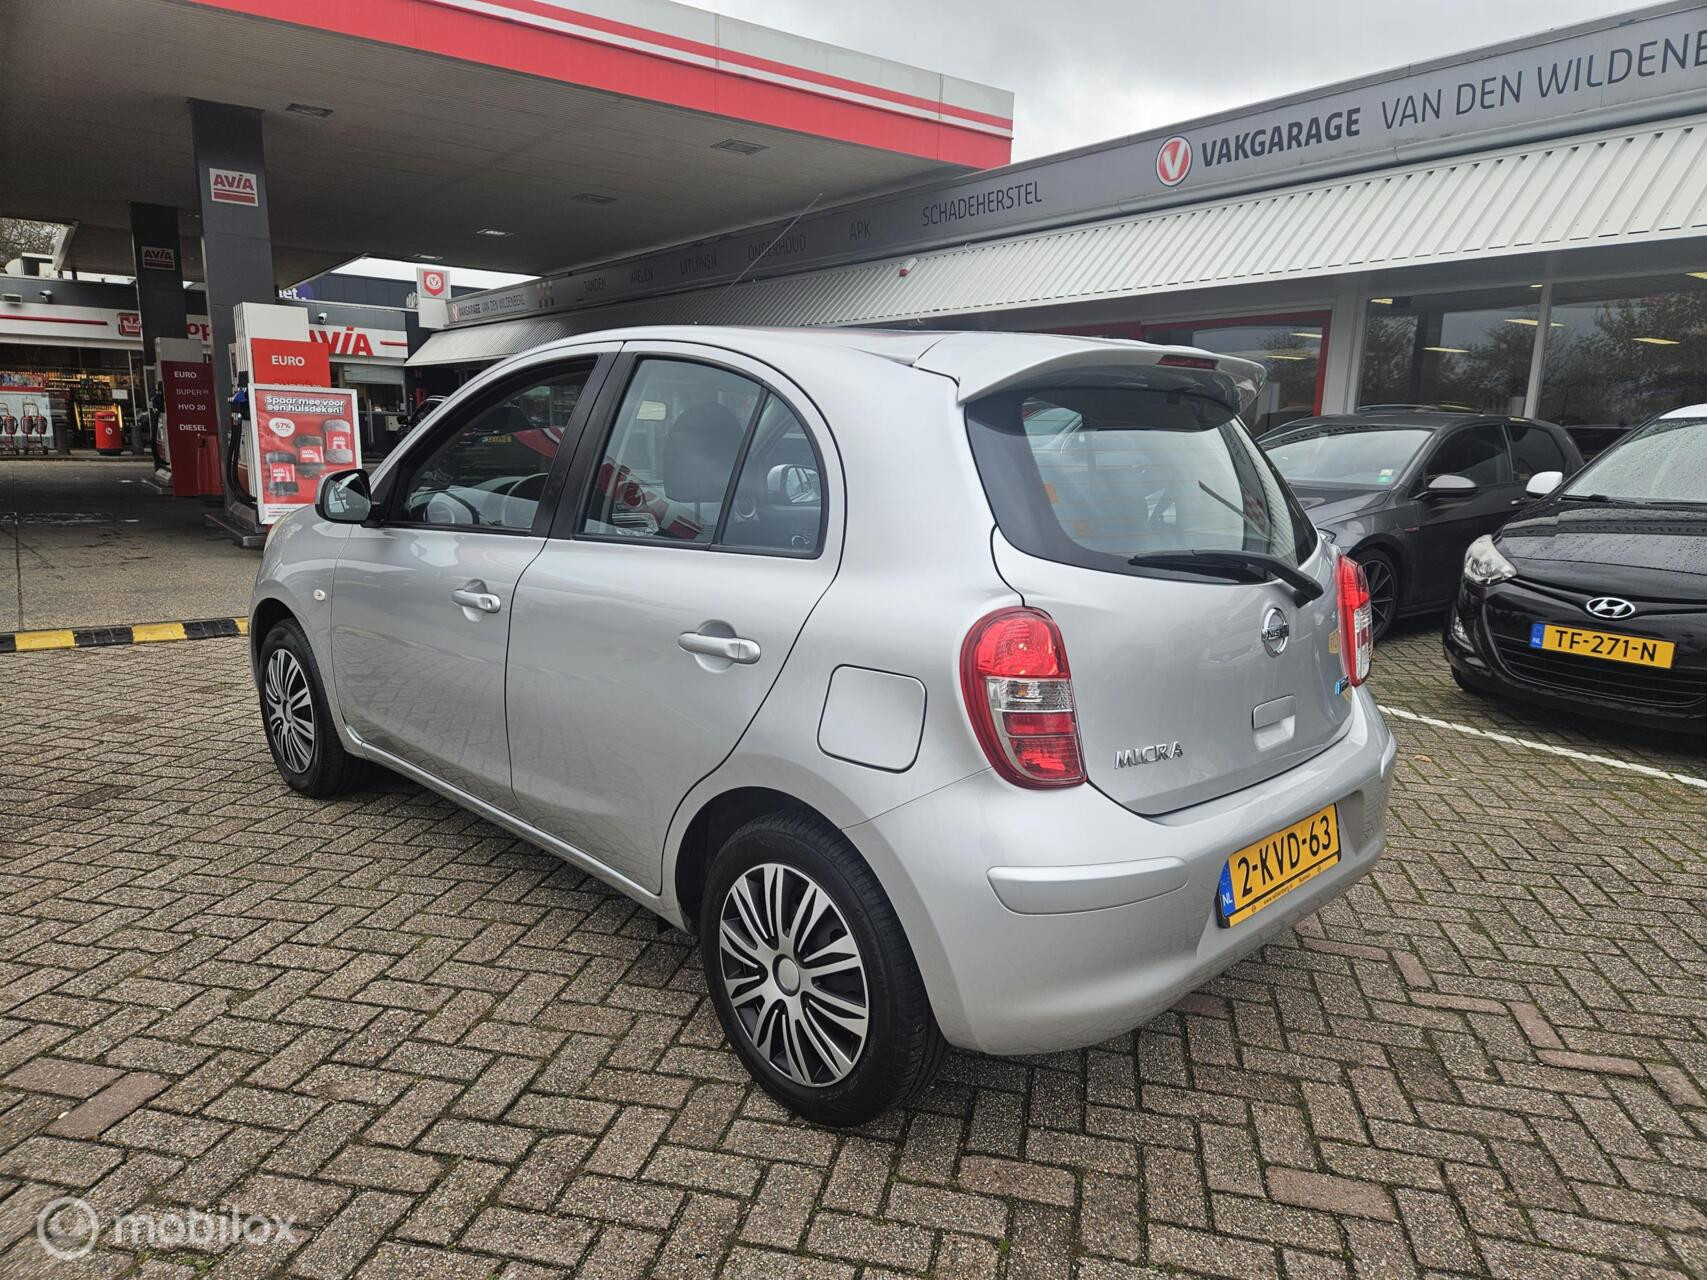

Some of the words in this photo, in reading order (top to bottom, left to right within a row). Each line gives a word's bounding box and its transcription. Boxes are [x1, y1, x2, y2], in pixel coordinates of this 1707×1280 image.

[1201, 106, 1361, 168] VAKGARAGE
[1381, 88, 1442, 130] VAN
[1455, 71, 1523, 116] DEN
[213, 174, 255, 191] AVIA
[747, 234, 807, 261] ONDERHOUD
[849, 218, 872, 241] APK
[922, 180, 1042, 227] SCHADEHERSTEL
[144, 249, 171, 260] AVIA
[271, 355, 305, 367] EURO
[174, 370, 197, 379] EURO
[176, 388, 202, 396] SUPER
[266, 395, 296, 405] Spaar
[298, 398, 321, 406] mee
[267, 403, 286, 411] een
[288, 403, 343, 413] huisdeken!
[179, 423, 207, 431] DIESEL
[1532, 636, 1541, 645] NL
[1555, 629, 1658, 662] TF-271-N
[1114, 741, 1184, 769] MICRA
[1238, 815, 1332, 898] 2-KVD-63
[1221, 892, 1233, 906] NL
